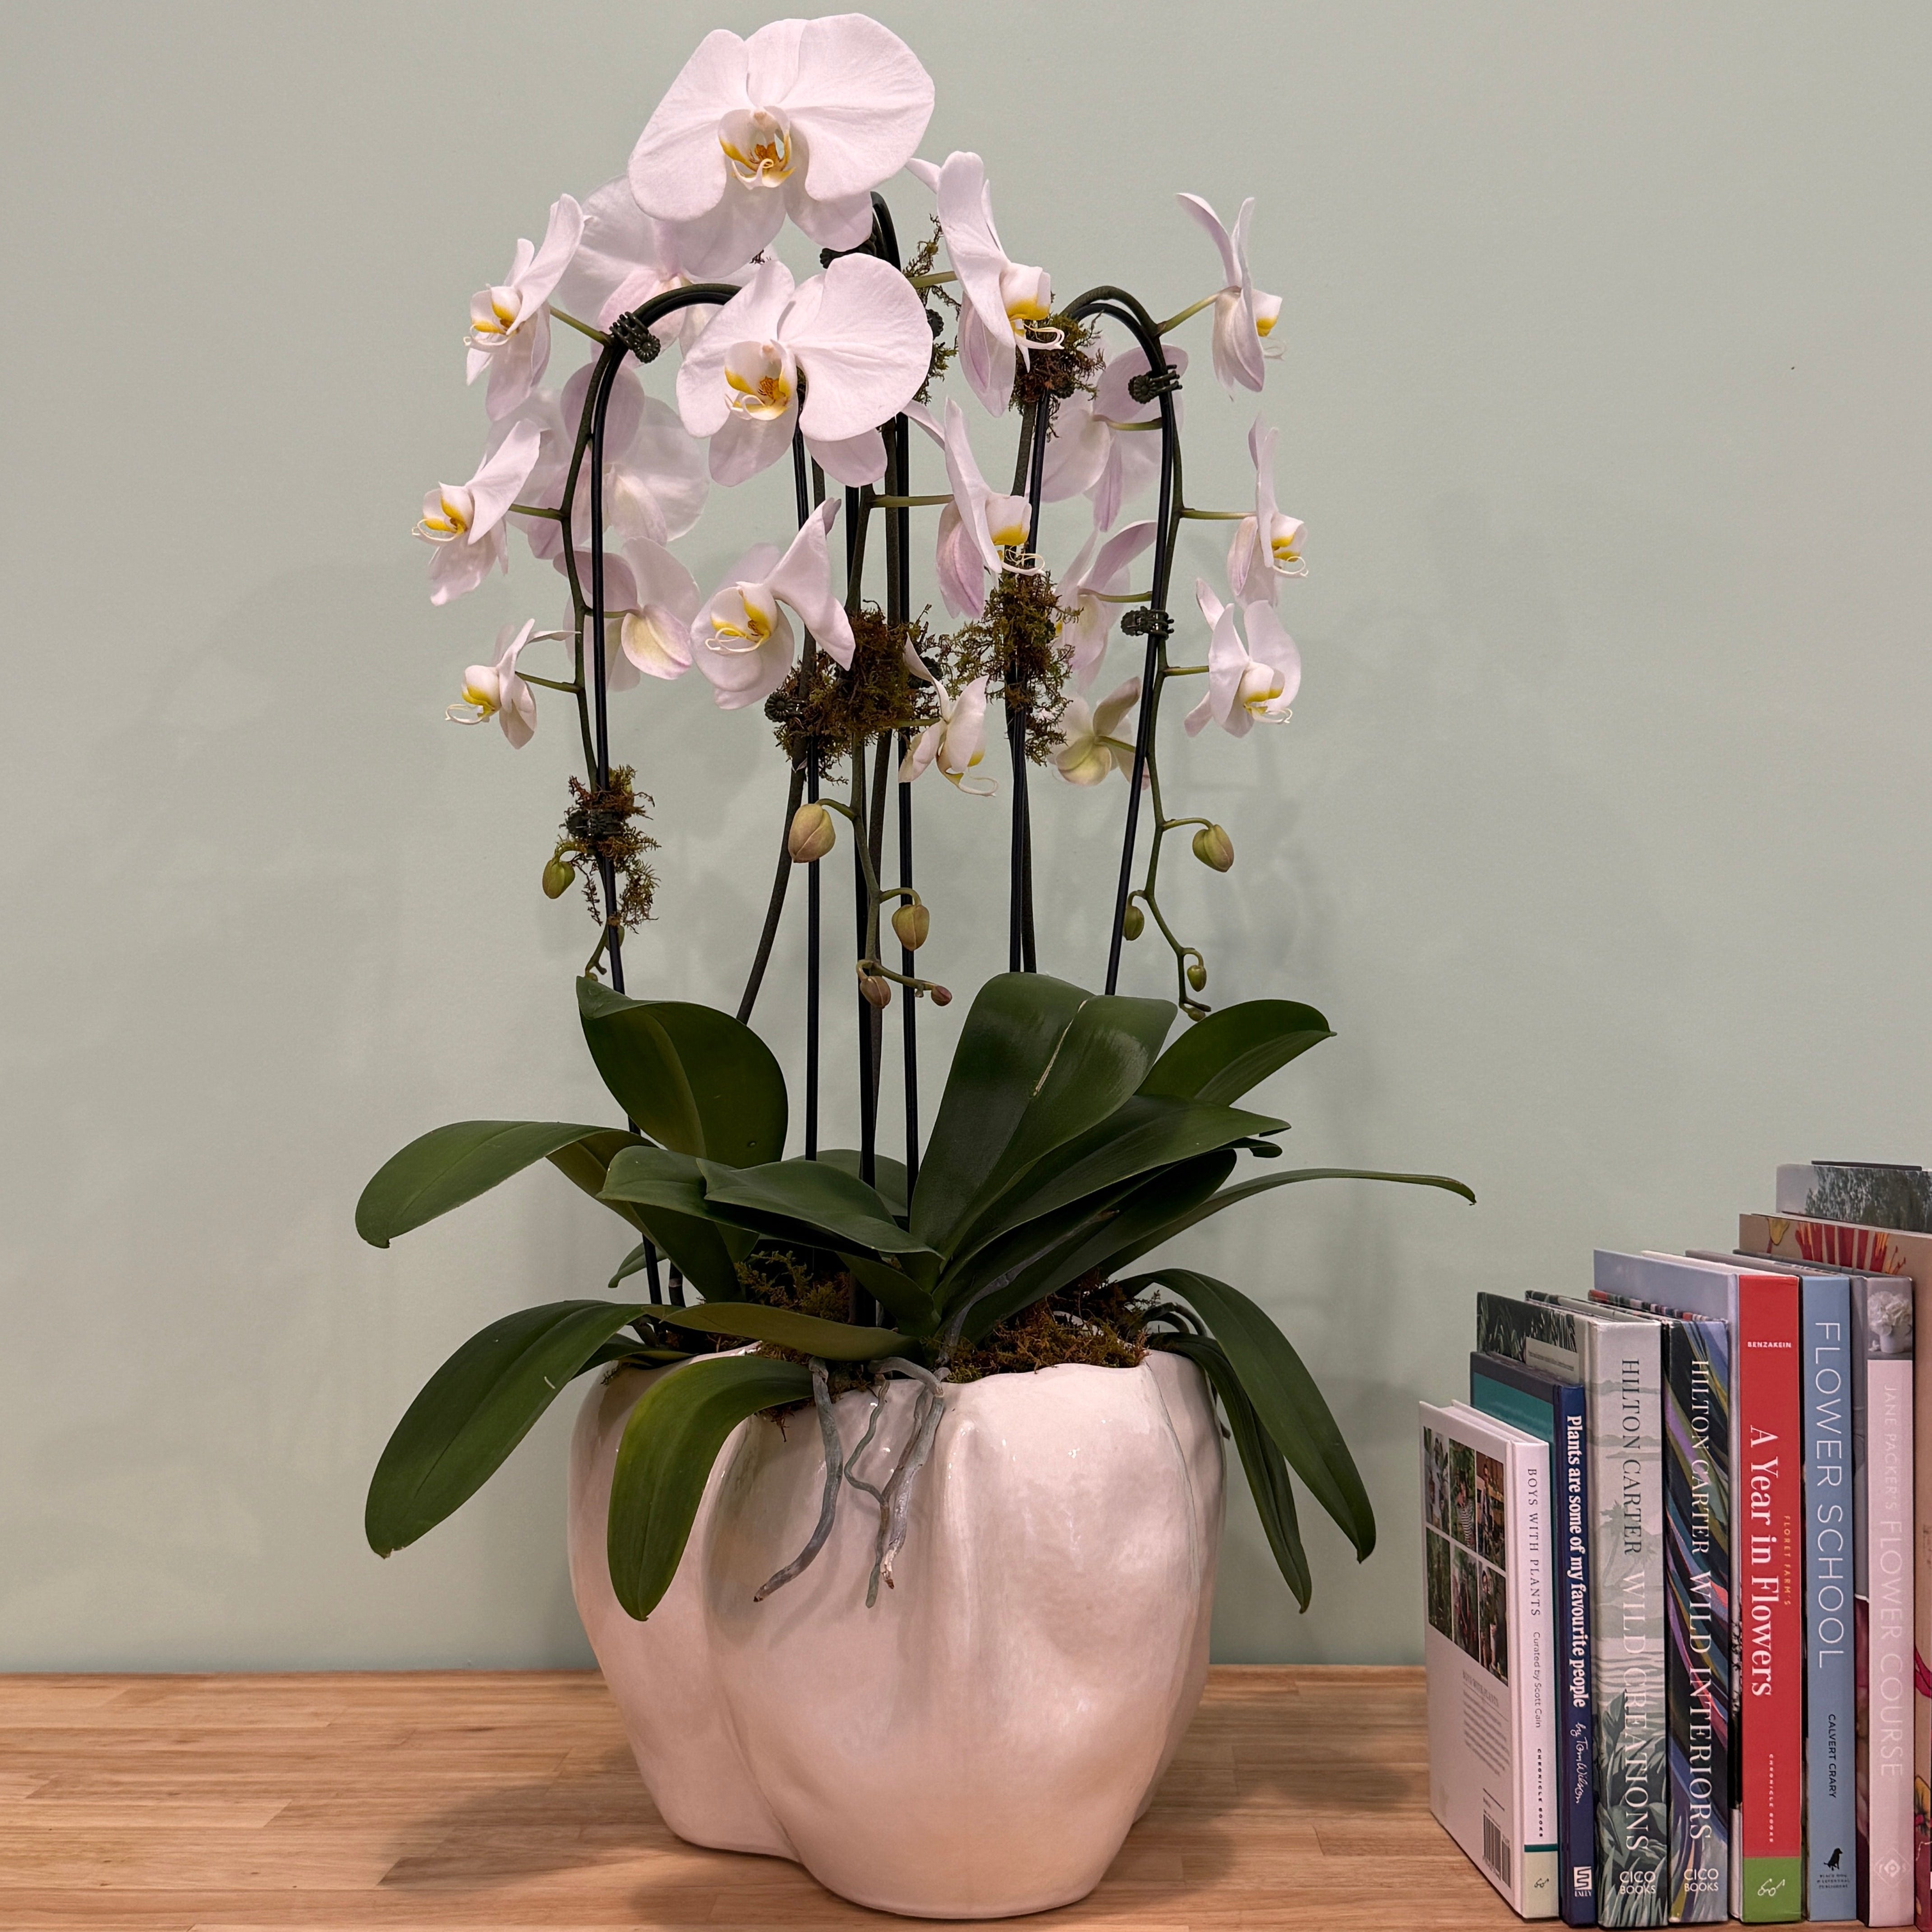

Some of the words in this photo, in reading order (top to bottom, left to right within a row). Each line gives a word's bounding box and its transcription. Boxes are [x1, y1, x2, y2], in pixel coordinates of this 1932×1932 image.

[1622, 1359, 1640, 1449] HILTON
[1692, 1360, 1709, 1449] HILTON
[1815, 1322, 1841, 1486] FLOWER
[1884, 1385, 1896, 1425] JANE
[1567, 1416, 1582, 1465] Plants
[1750, 1425, 1777, 1448] A
[1528, 1469, 1538, 1506] BOYS
[1568, 1467, 1582, 1492] are
[1751, 1456, 1777, 1526] Year
[1885, 1434, 1896, 1510] PACKER'S
[1569, 1495, 1582, 1534] some
[1623, 1459, 1641, 1555] CARTER
[1691, 1459, 1709, 1555] CARTER
[1529, 1513, 1539, 1551] WITH
[1570, 1536, 1584, 1554] of
[1751, 1534, 1776, 1565] in
[1530, 1559, 1541, 1616] PLANTS
[1567, 1556, 1583, 1580] my
[1817, 1504, 1843, 1668] SCHOOL
[1880, 1521, 1902, 1639] FLOWER
[1571, 1583, 1587, 1656] favourite
[1623, 1571, 1645, 1654] WILD
[1689, 1570, 1711, 1654] WILD
[1751, 1575, 1779, 1696] Flowers
[1533, 1670, 1541, 1680] by
[1569, 1658, 1588, 1707] people
[1570, 1722, 1585, 1737] by
[1880, 1654, 1902, 1776] COURSE
[1576, 1737, 1587, 1762] Tom
[1624, 1667, 1648, 1850] CREATIONS
[1689, 1668, 1711, 1840] INTERIORS
[1575, 1762, 1587, 1804] Wilson
[1829, 1763, 1837, 1798] CRARY
[1619, 1871, 1656, 1883] CICO
[1620, 1885, 1656, 1894] BOOKS
[1684, 1868, 1719, 1881] CICO
[1684, 1882, 1719, 1891] BOOKS
